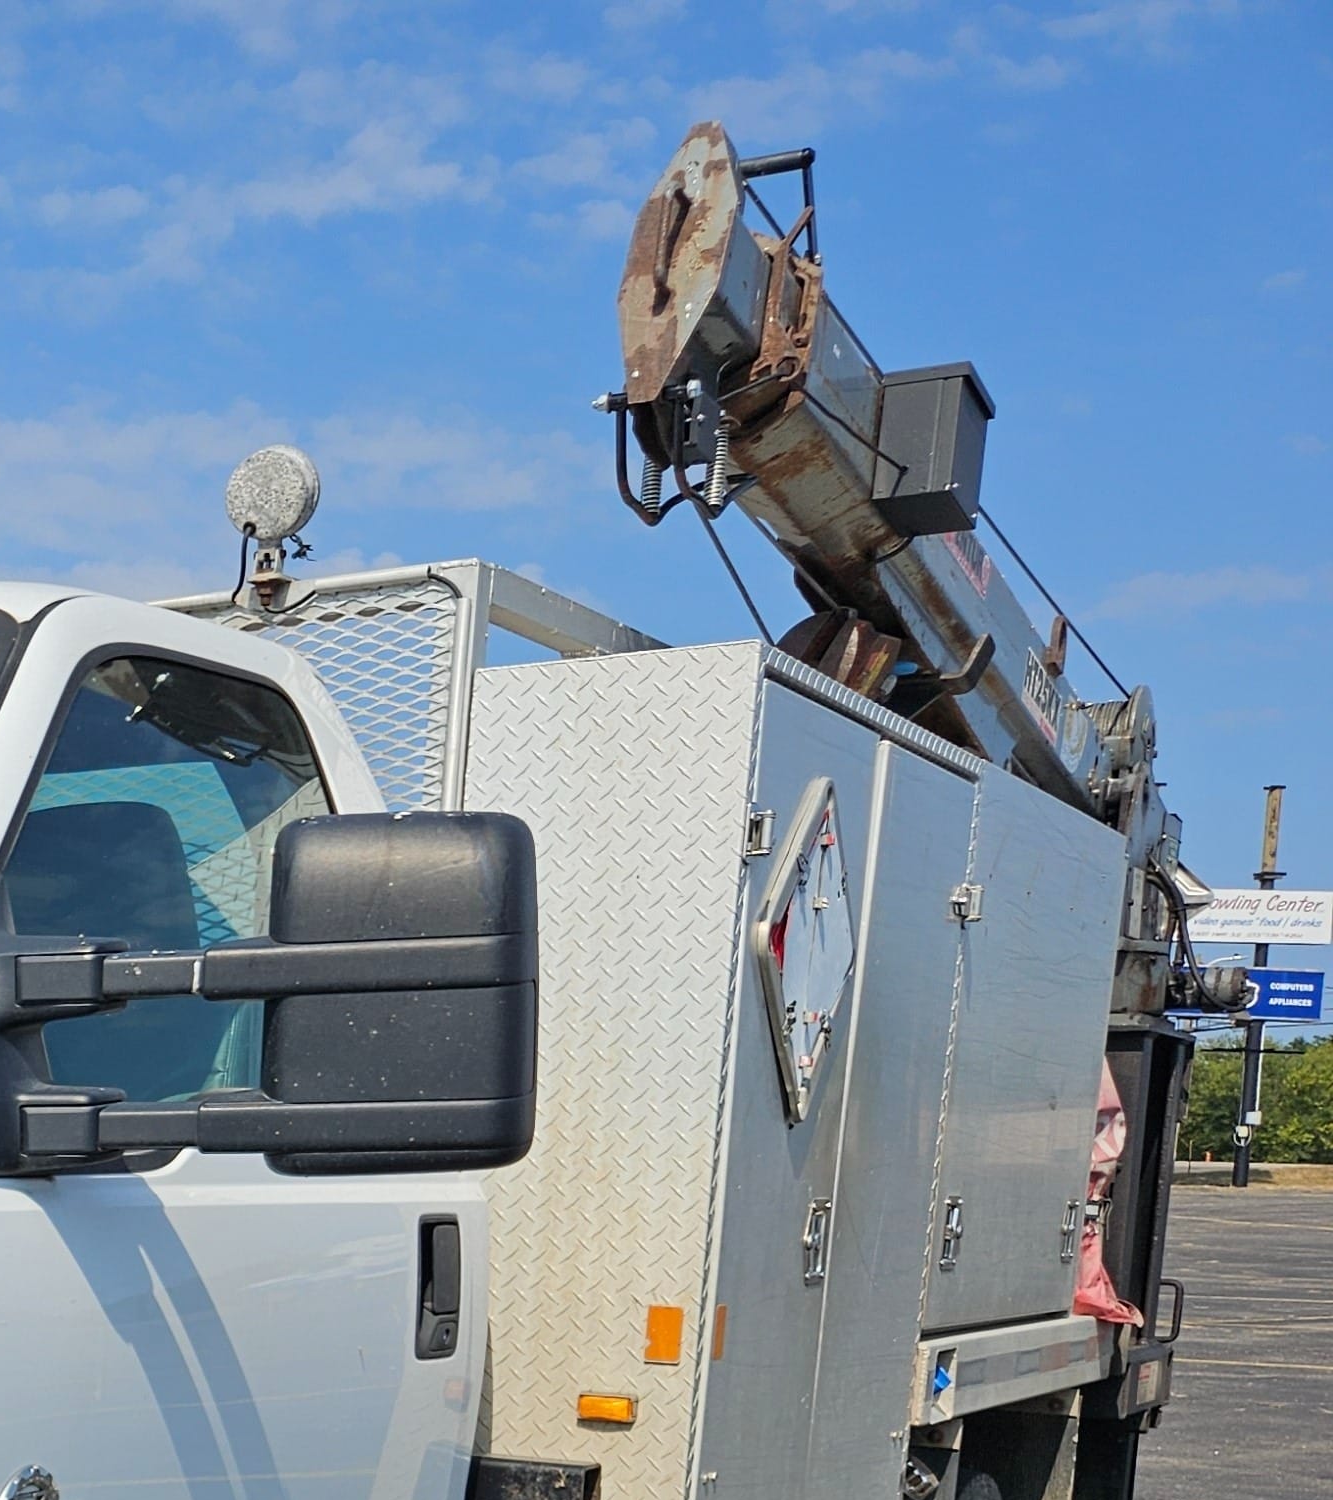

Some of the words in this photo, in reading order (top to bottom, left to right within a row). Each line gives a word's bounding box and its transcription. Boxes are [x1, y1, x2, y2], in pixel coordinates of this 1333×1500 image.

[1210, 895, 1262, 915] owling
[1266, 894, 1324, 913] Center
[1258, 917, 1282, 927] food
[1289, 917, 1323, 928] drinks
[1269, 982, 1314, 992] COMPUTERS
[1268, 997, 1313, 1007] APPLIANCES
